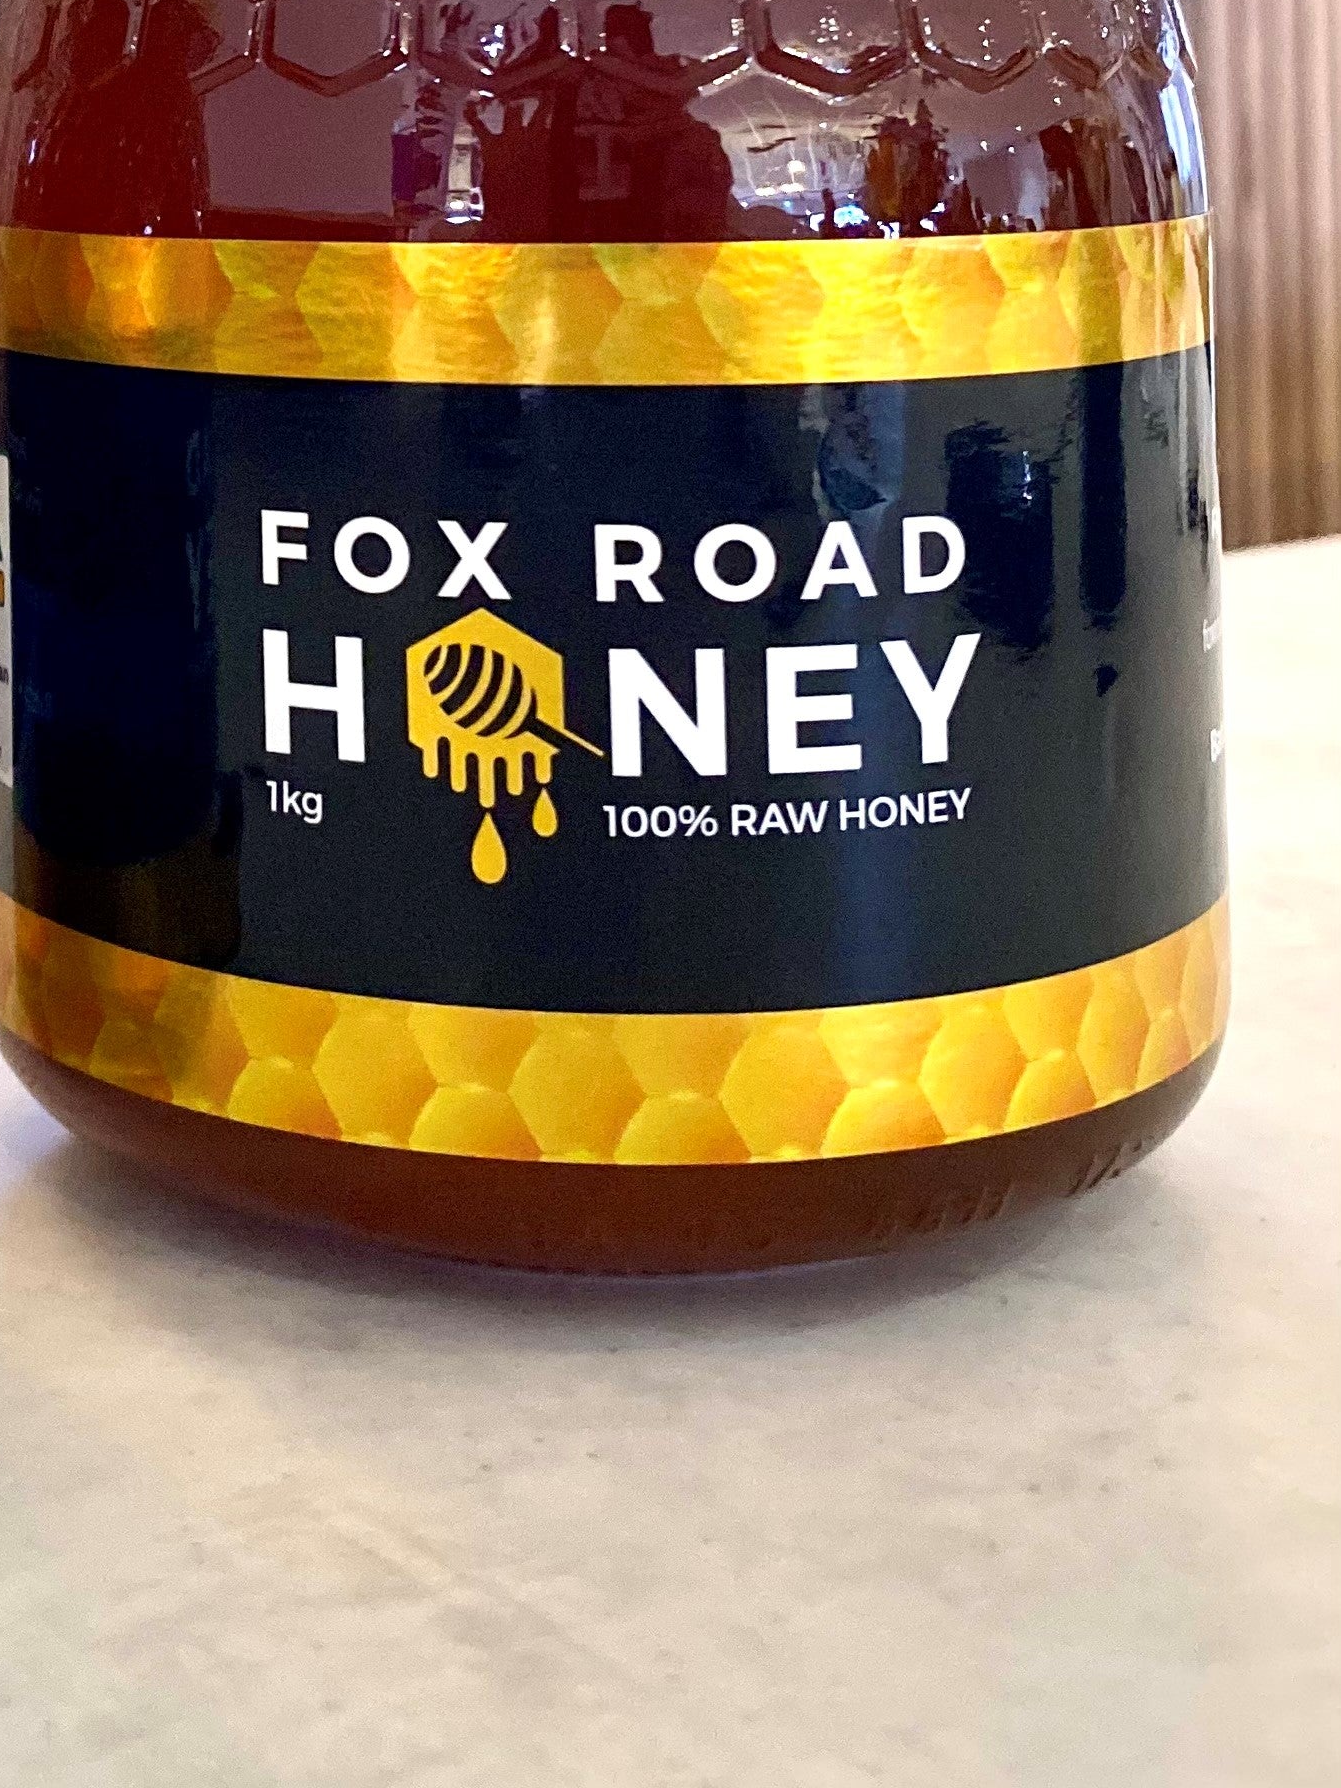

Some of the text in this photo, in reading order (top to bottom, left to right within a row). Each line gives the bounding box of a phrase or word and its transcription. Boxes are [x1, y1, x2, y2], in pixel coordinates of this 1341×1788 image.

[261, 509, 966, 603] FOX ROAD
[265, 780, 323, 824] 1kg
[602, 787, 972, 838] 100% RAW HONEY
